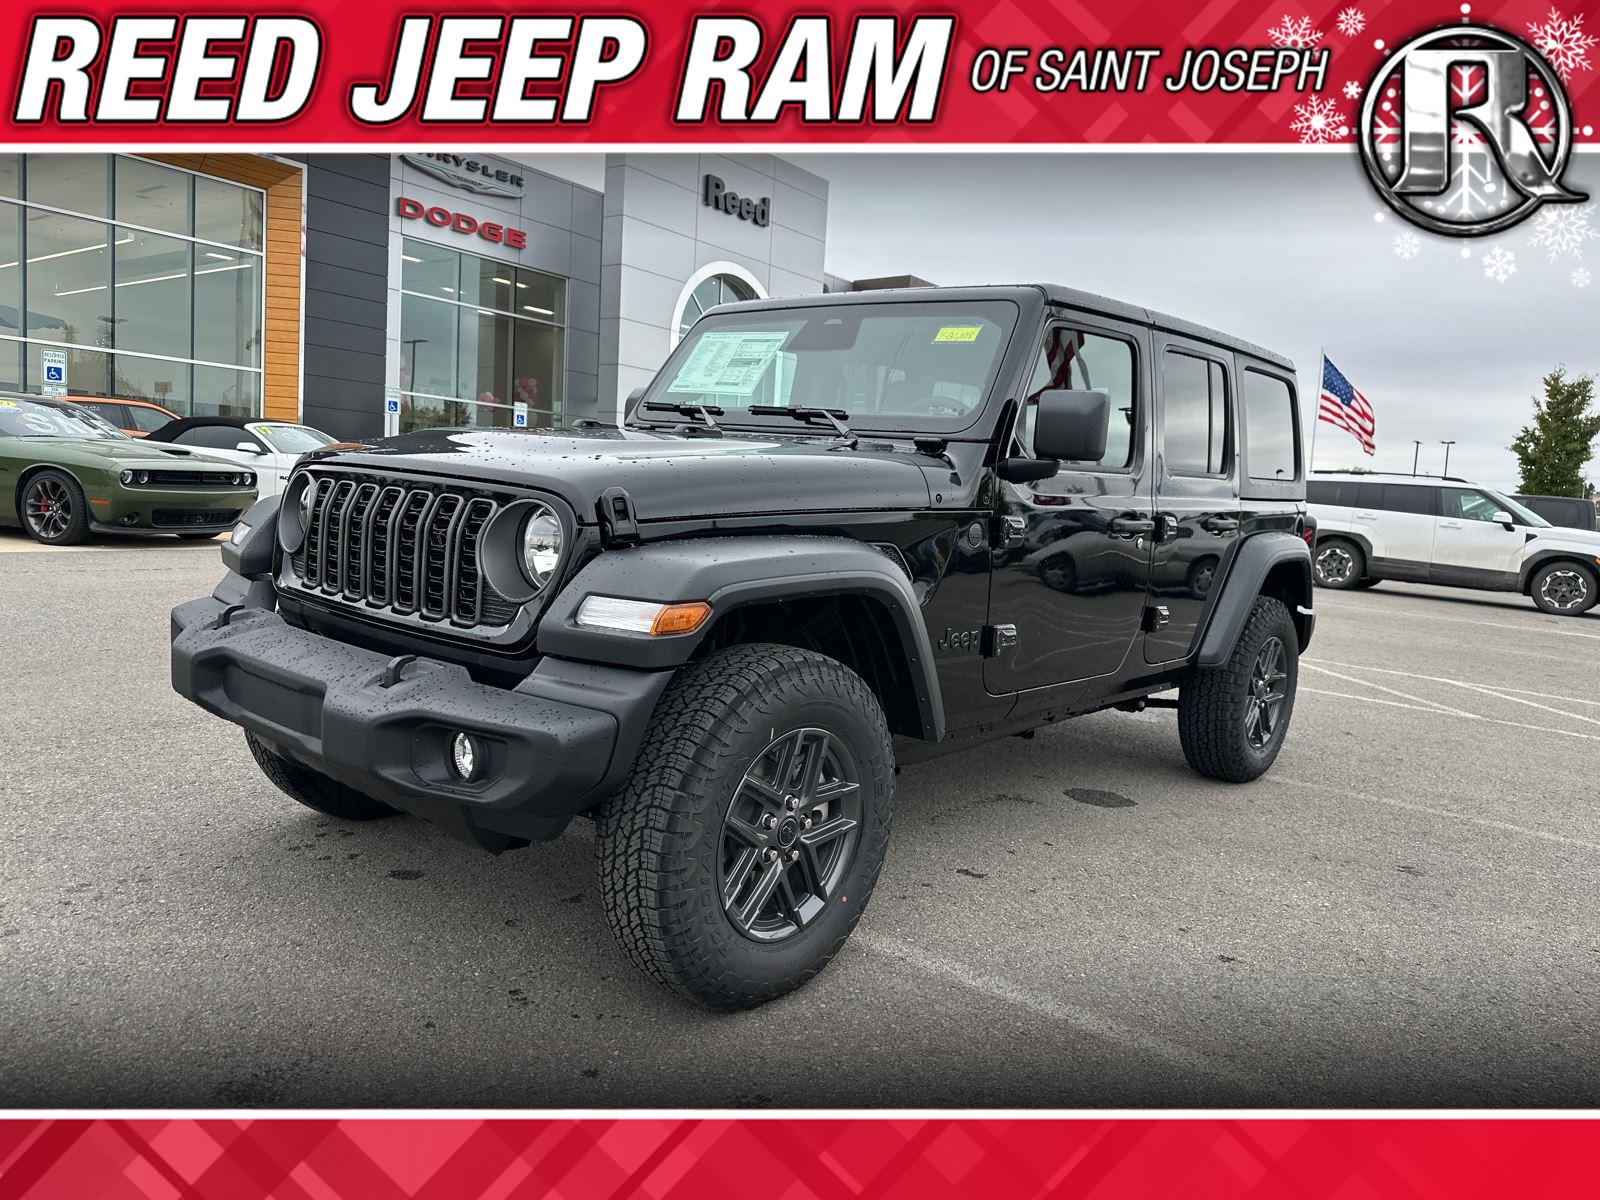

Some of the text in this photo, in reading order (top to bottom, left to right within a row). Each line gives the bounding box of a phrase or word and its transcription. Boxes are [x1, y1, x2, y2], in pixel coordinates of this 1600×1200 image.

[397, 197, 527, 249] DODGE
[703, 173, 771, 228] Reed
[937, 627, 979, 652] Jeep
